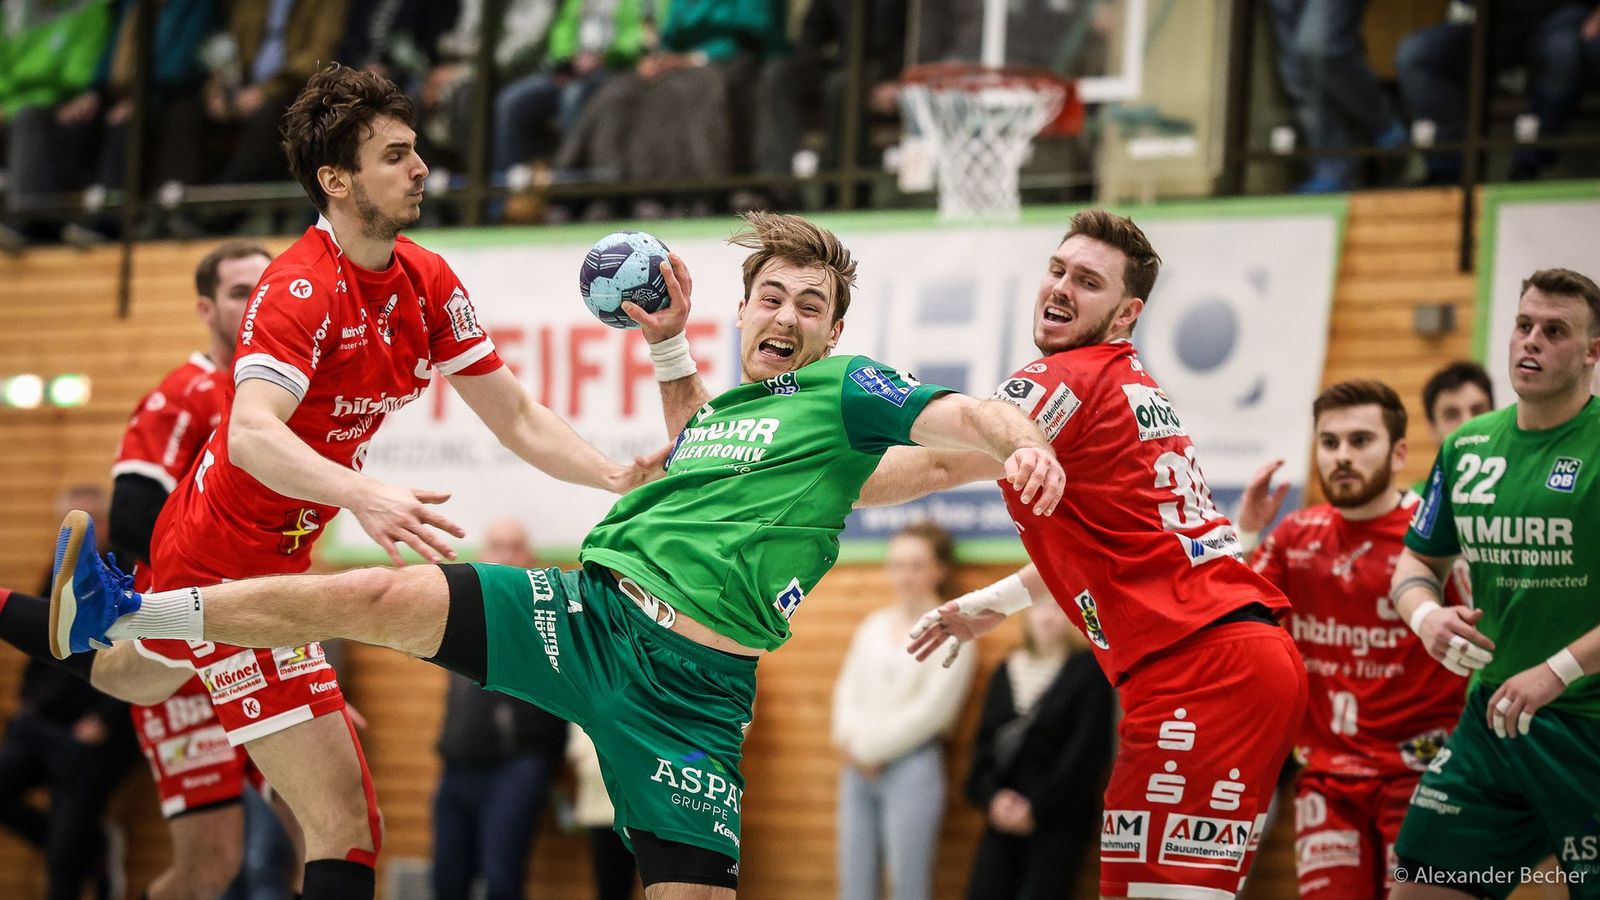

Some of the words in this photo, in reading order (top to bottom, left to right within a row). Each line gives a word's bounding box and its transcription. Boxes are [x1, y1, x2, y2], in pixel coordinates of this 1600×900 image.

[1451, 453, 1507, 505] 22
[1554, 460, 1578, 473] HC
[1549, 473, 1574, 488] OB
[1475, 515, 1574, 546] MURR
[214, 662, 258, 688] Körner
[670, 793, 729, 821] GRUPPE
